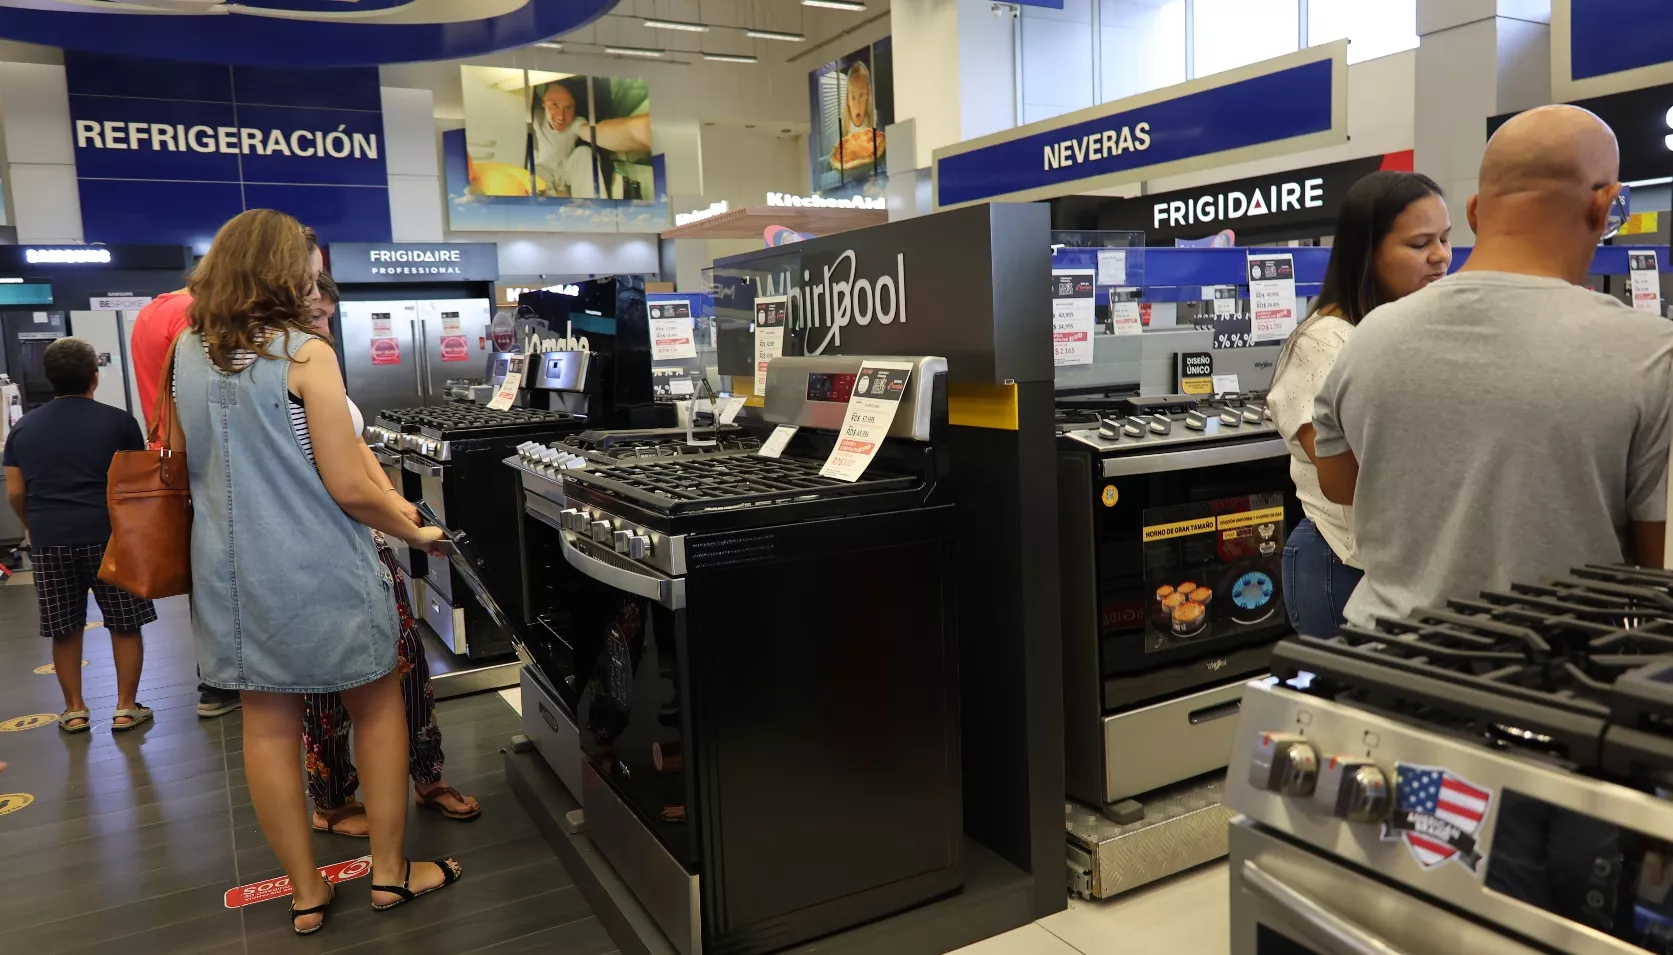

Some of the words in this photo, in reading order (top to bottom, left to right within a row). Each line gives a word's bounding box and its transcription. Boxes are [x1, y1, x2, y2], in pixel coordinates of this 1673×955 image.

[75, 119, 379, 160] REFRIGERACIÓN
[1043, 121, 1152, 172] NEVERAS
[766, 192, 886, 210] KitchenAid
[1153, 177, 1324, 229] FRIGIDAIRE
[370, 249, 461, 262] FRIGIDAIRE
[371, 266, 462, 275] PROFESSIONAL
[756, 249, 907, 357] Whirlpool
[1186, 355, 1210, 365] DISEÑO
[1186, 365, 1210, 375] ÚNICO
[1145, 529, 1166, 538] HORNO
[1174, 525, 1190, 533] GRAN
[1190, 521, 1214, 531] TAMAÑO
